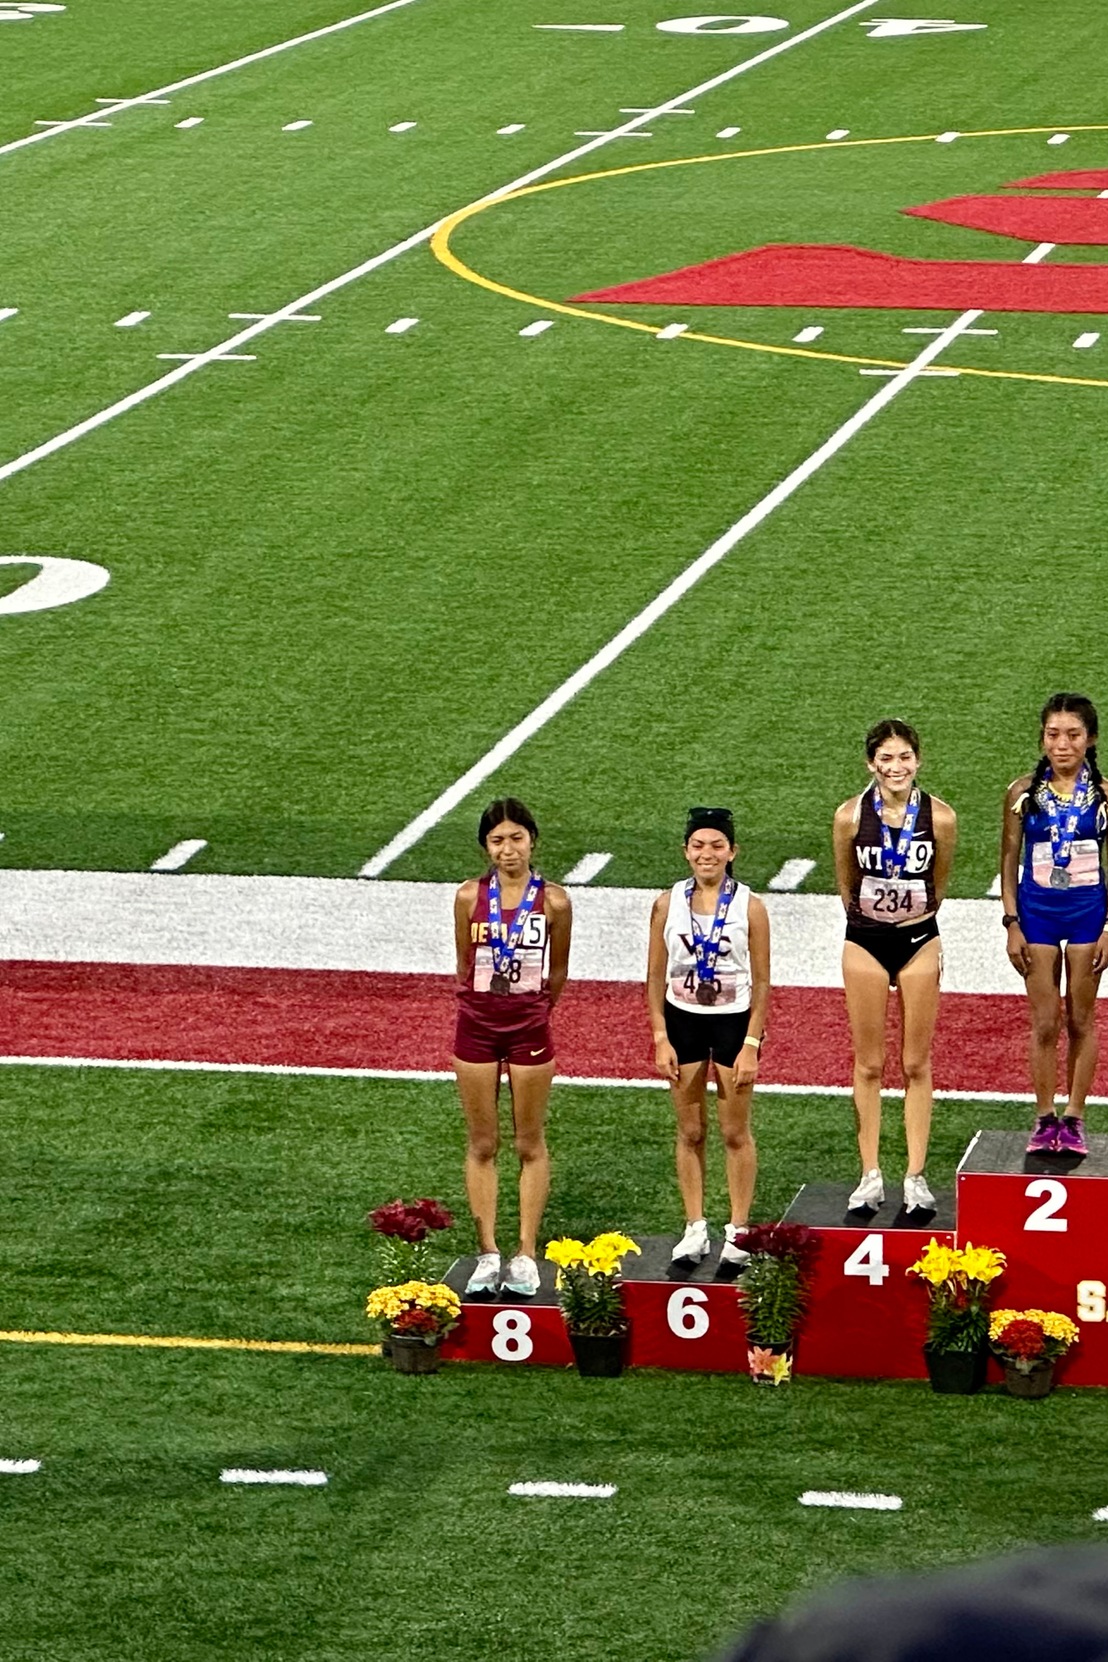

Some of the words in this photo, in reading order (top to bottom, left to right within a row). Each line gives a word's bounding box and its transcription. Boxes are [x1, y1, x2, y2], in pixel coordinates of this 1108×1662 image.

[915, 843, 928, 871] 9
[873, 888, 913, 913] 234
[529, 917, 541, 944] 5
[1023, 1179, 1068, 1232] 2
[843, 1234, 889, 1286] 4
[491, 1310, 534, 1361] 8
[666, 1288, 710, 1339] 6
